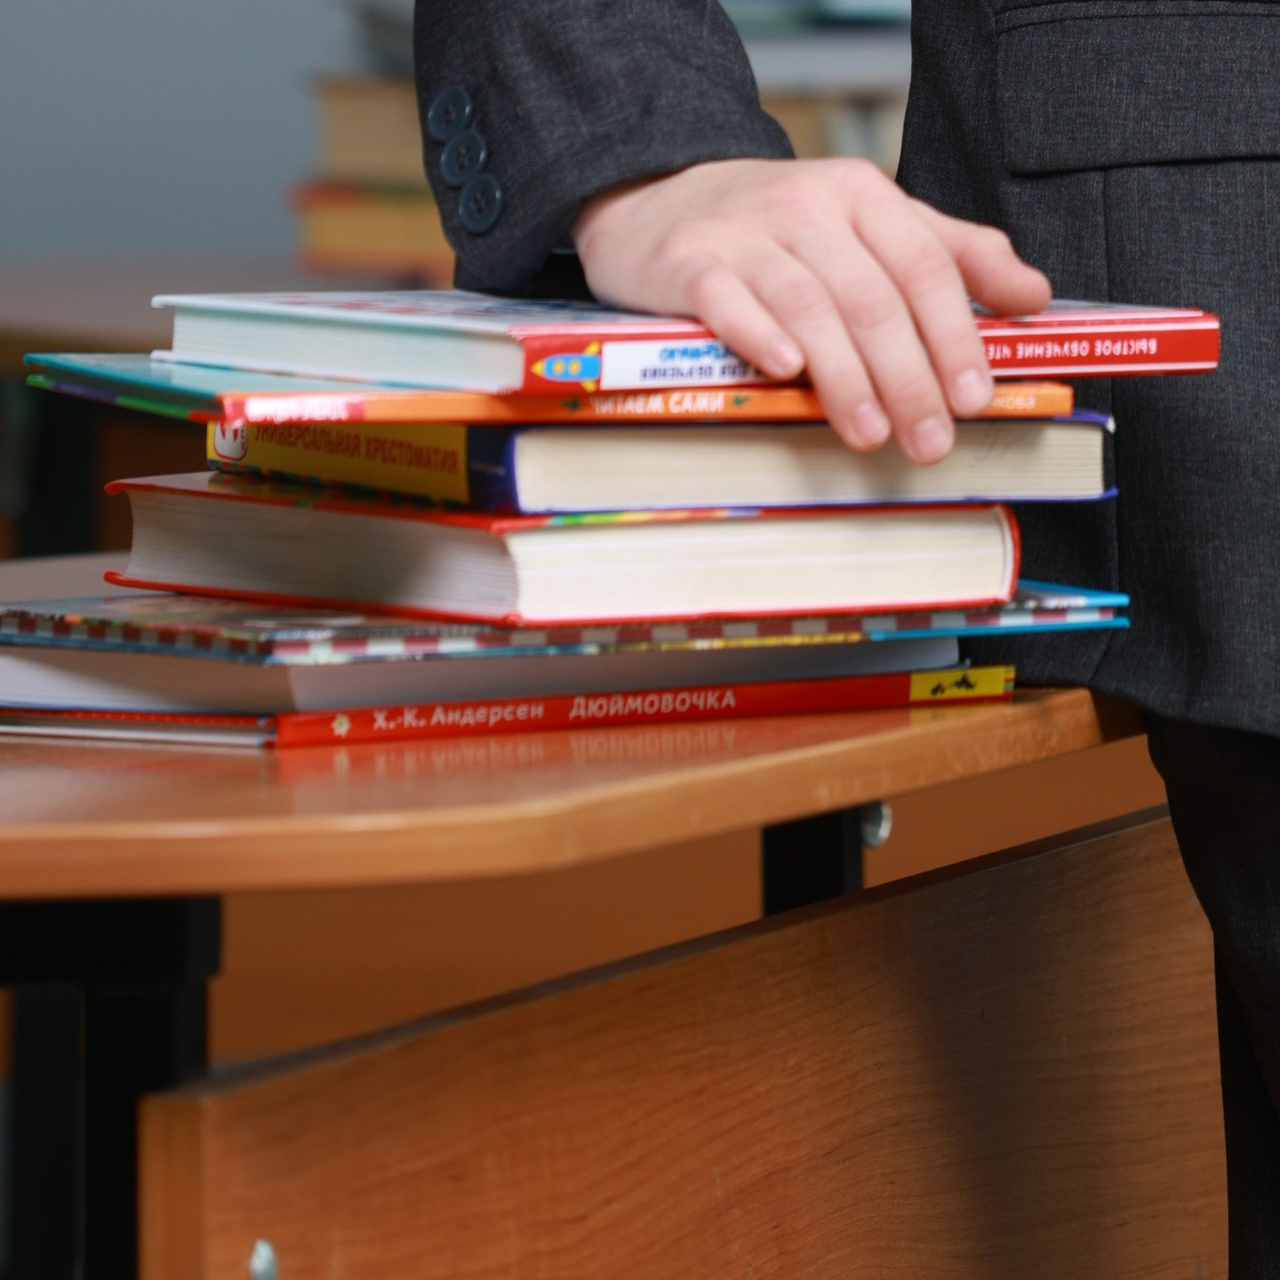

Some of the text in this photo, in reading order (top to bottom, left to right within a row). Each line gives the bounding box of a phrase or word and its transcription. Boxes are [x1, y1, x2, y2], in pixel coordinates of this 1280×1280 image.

[984, 338, 1157, 360] БЫСТРОЕ ОБУЧЕНИЕ ЧТЕ
[590, 390, 724, 415] ЧИТАЕМ САМИ
[364, 436, 459, 474] ХРЕСТОМАТИЯ
[430, 703, 545, 727] Андерсен
[569, 689, 736, 721] ДЮЙМОВОЧКА
